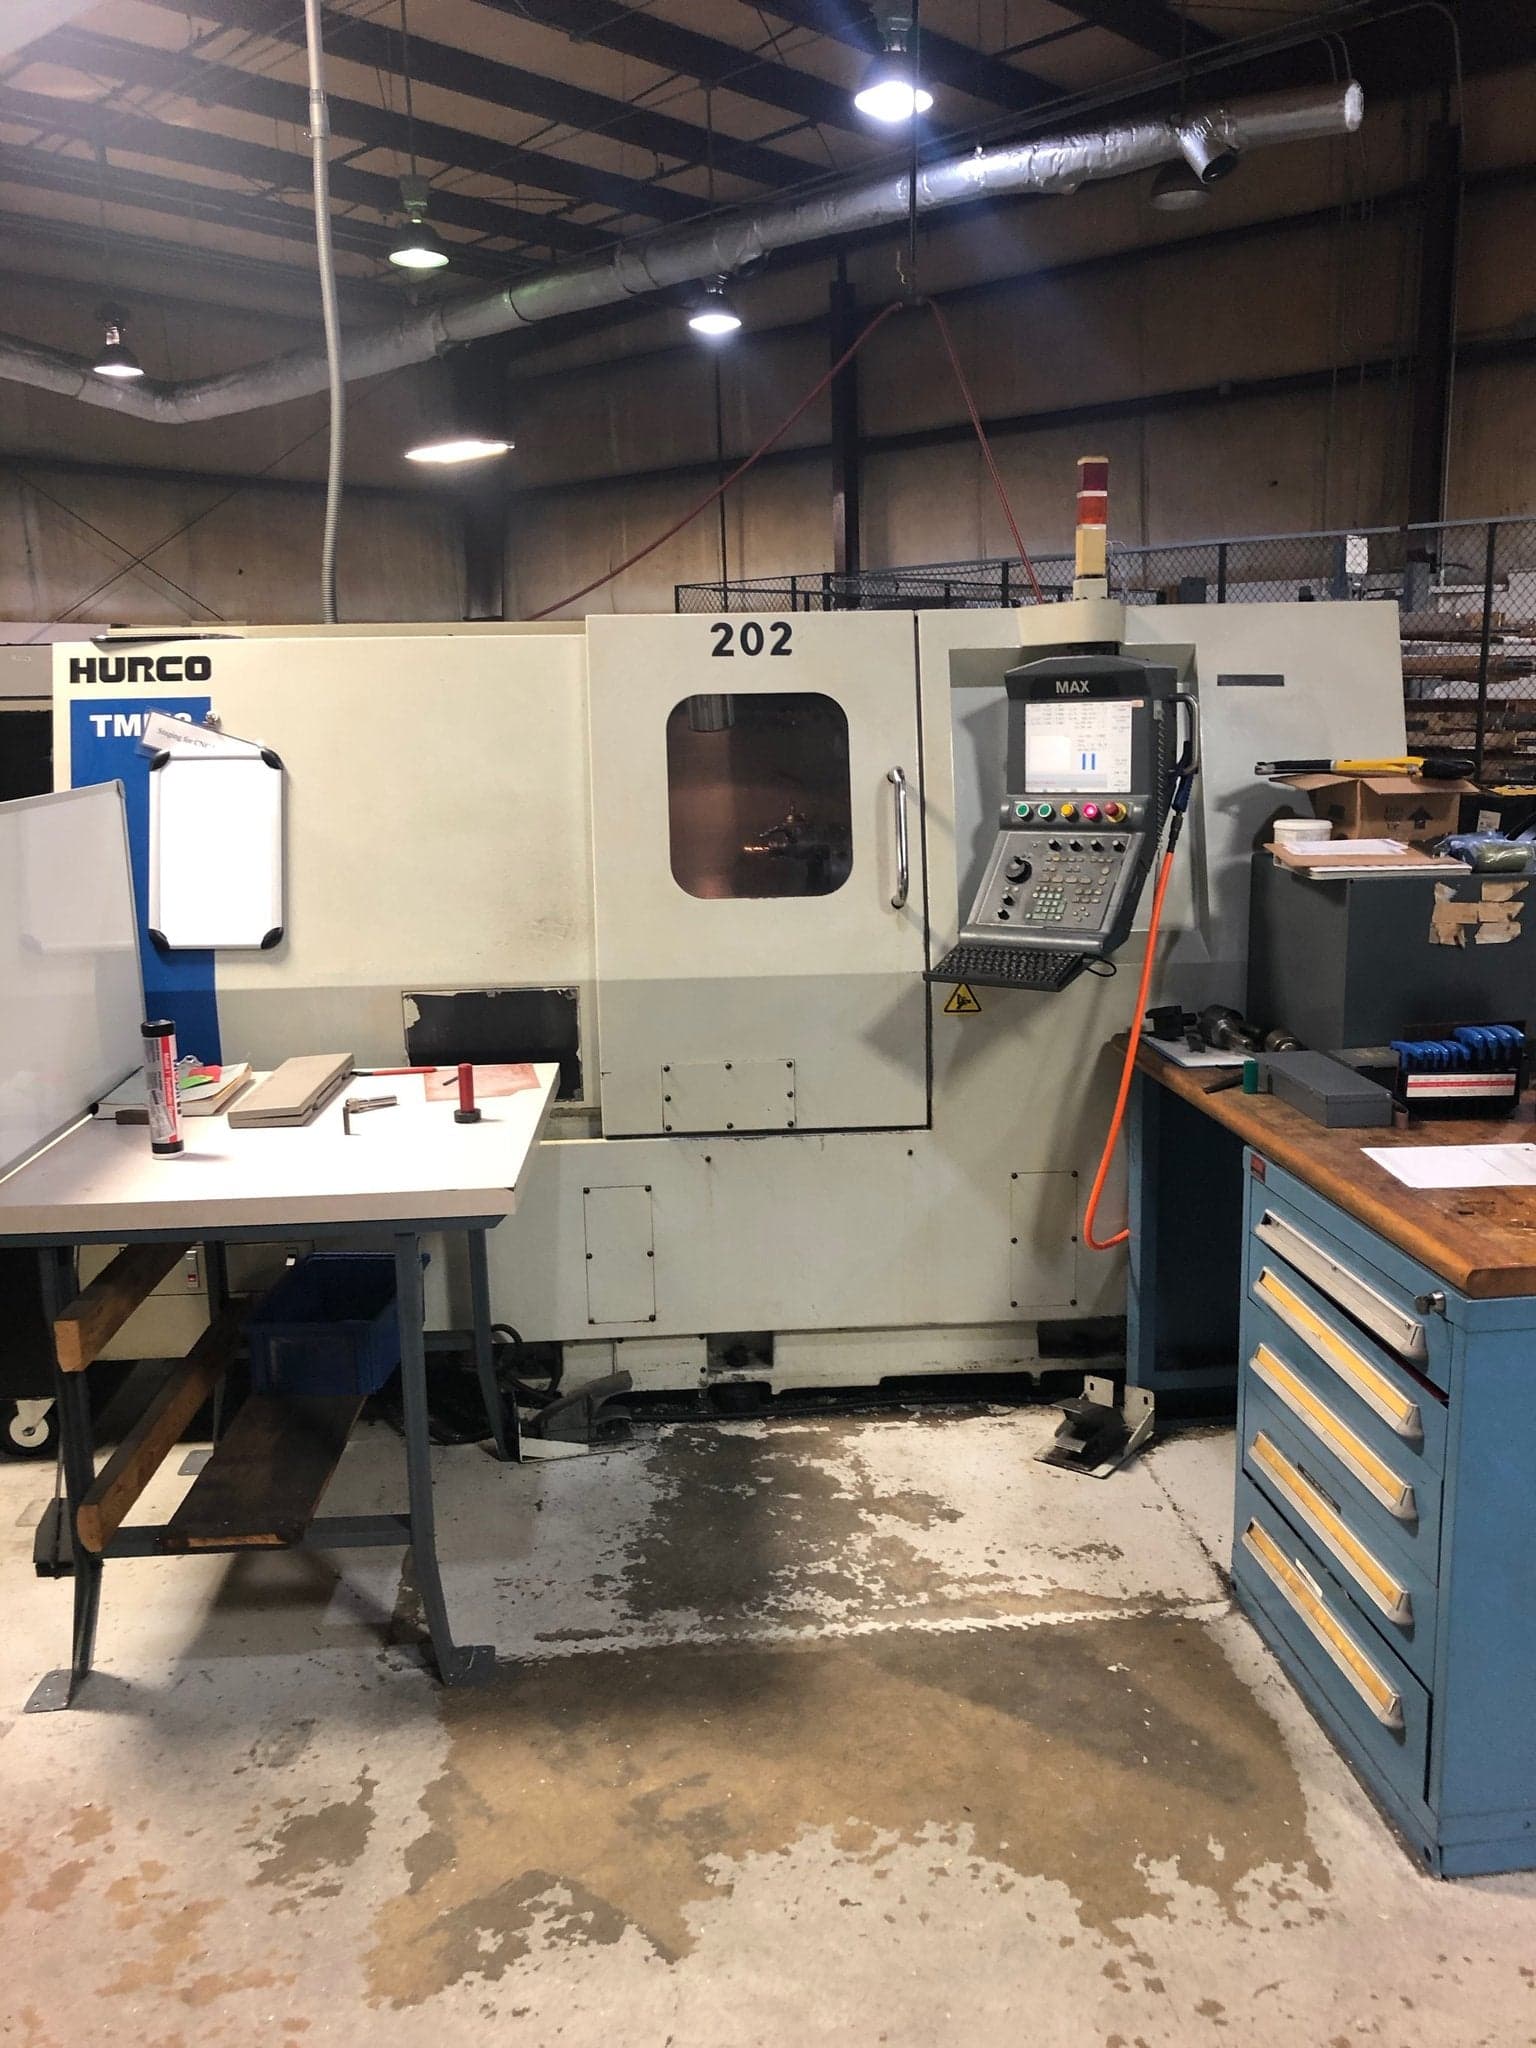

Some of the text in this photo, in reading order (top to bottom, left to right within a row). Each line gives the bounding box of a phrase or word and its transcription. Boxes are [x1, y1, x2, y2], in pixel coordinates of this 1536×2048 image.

[711, 621, 792, 657] 202
[70, 656, 211, 683] HURCO
[1056, 680, 1090, 694] MAX
